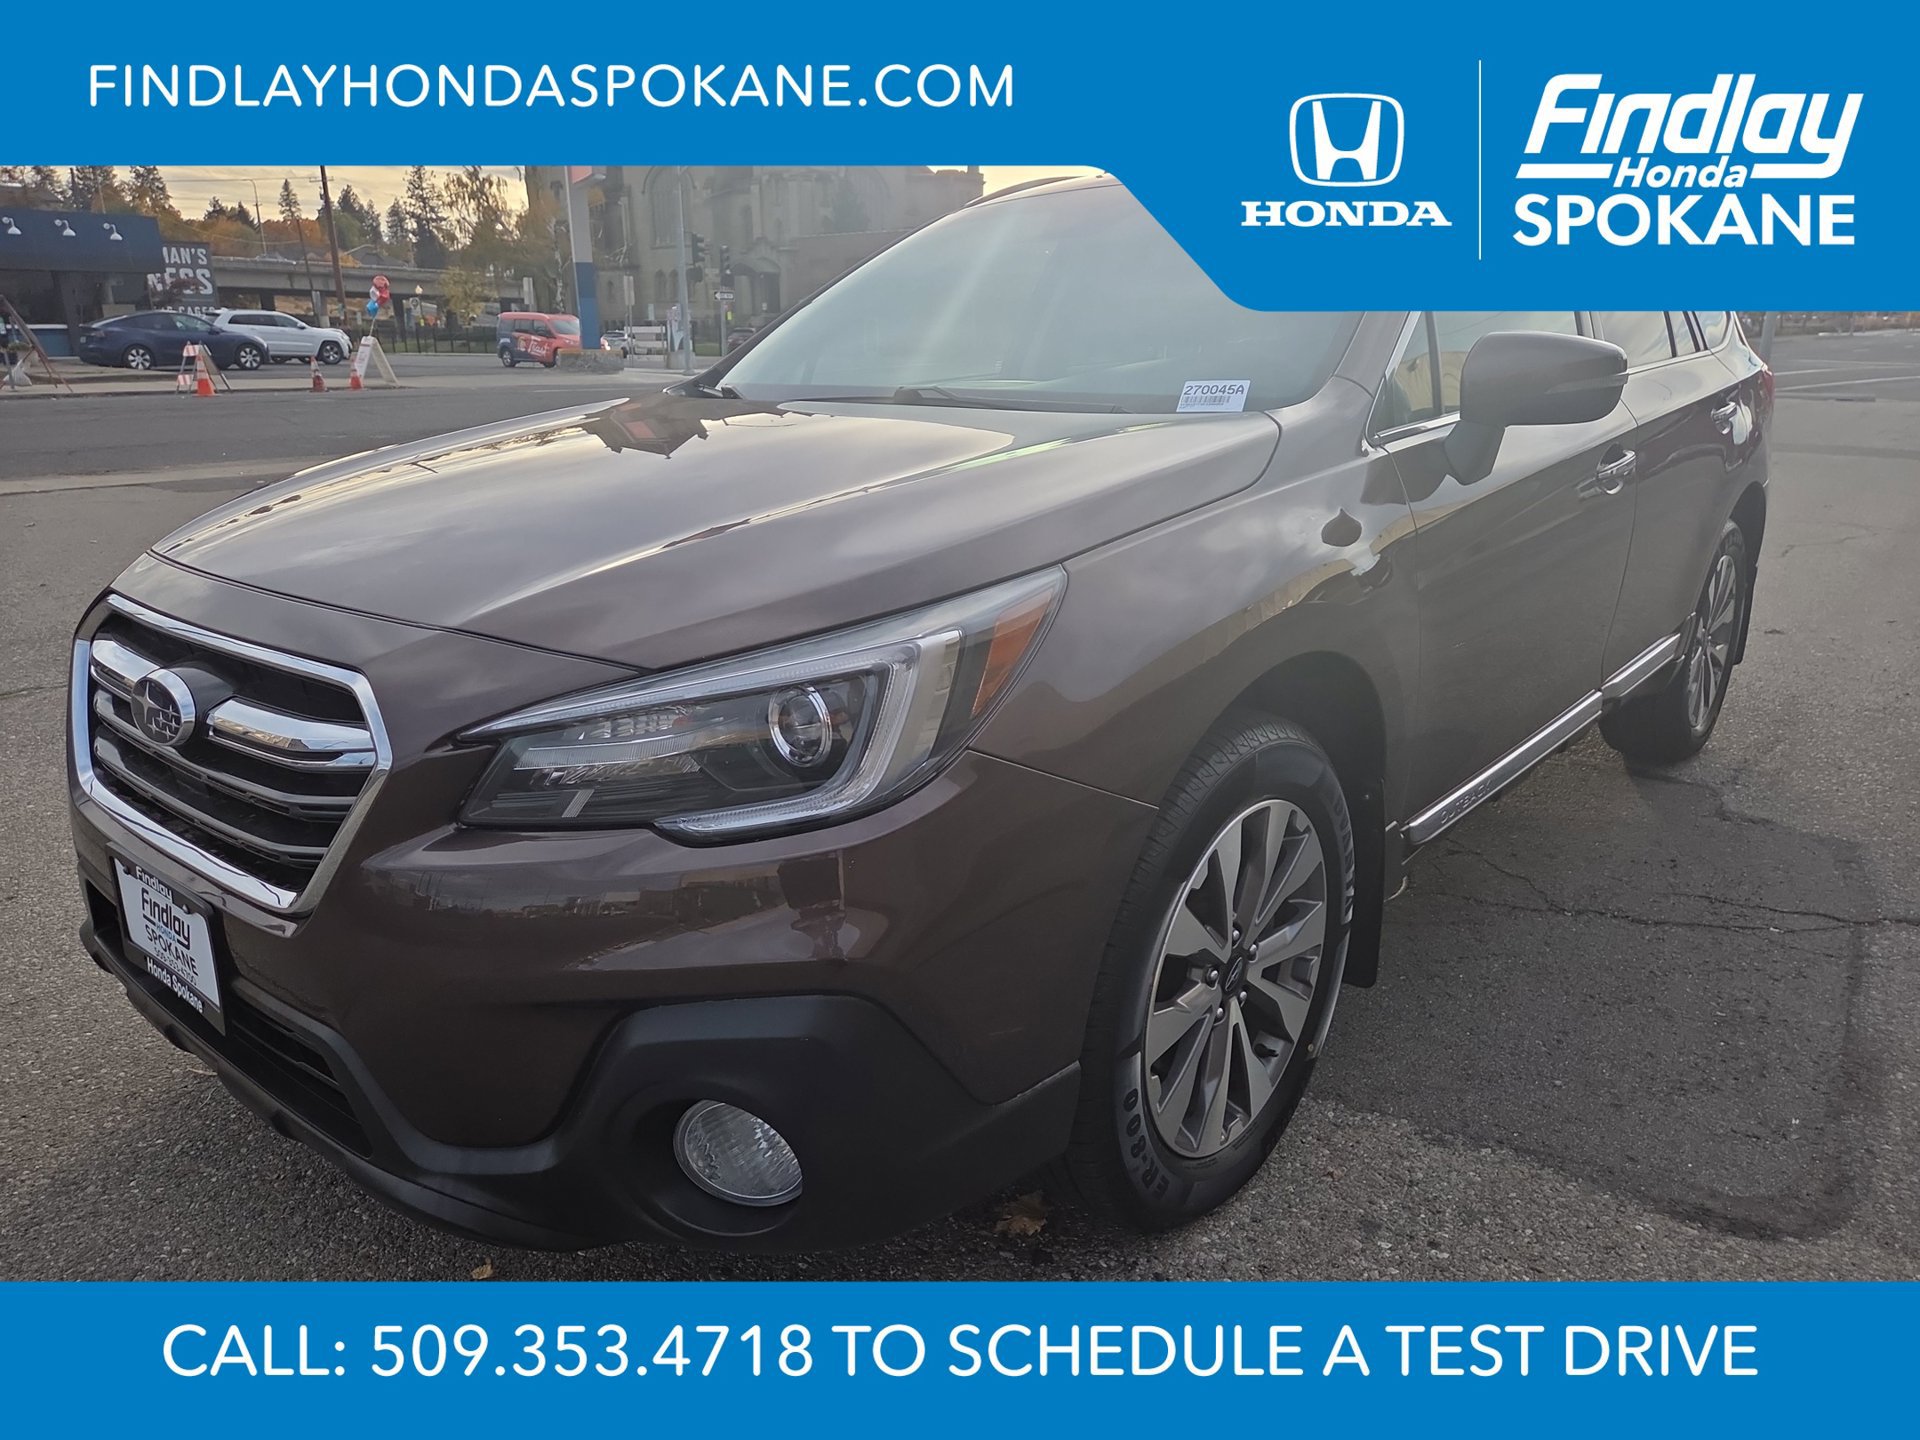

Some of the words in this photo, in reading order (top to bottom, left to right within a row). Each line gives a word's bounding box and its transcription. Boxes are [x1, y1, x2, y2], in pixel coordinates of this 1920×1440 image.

[1183, 384, 1246, 396] 270045A
[135, 865, 174, 904] Findlay
[141, 887, 191, 951] Findlay
[155, 922, 178, 943] HONDA
[145, 923, 199, 977] SPOKANE
[146, 956, 172, 987] Honda
[171, 974, 204, 1014] Spokane
